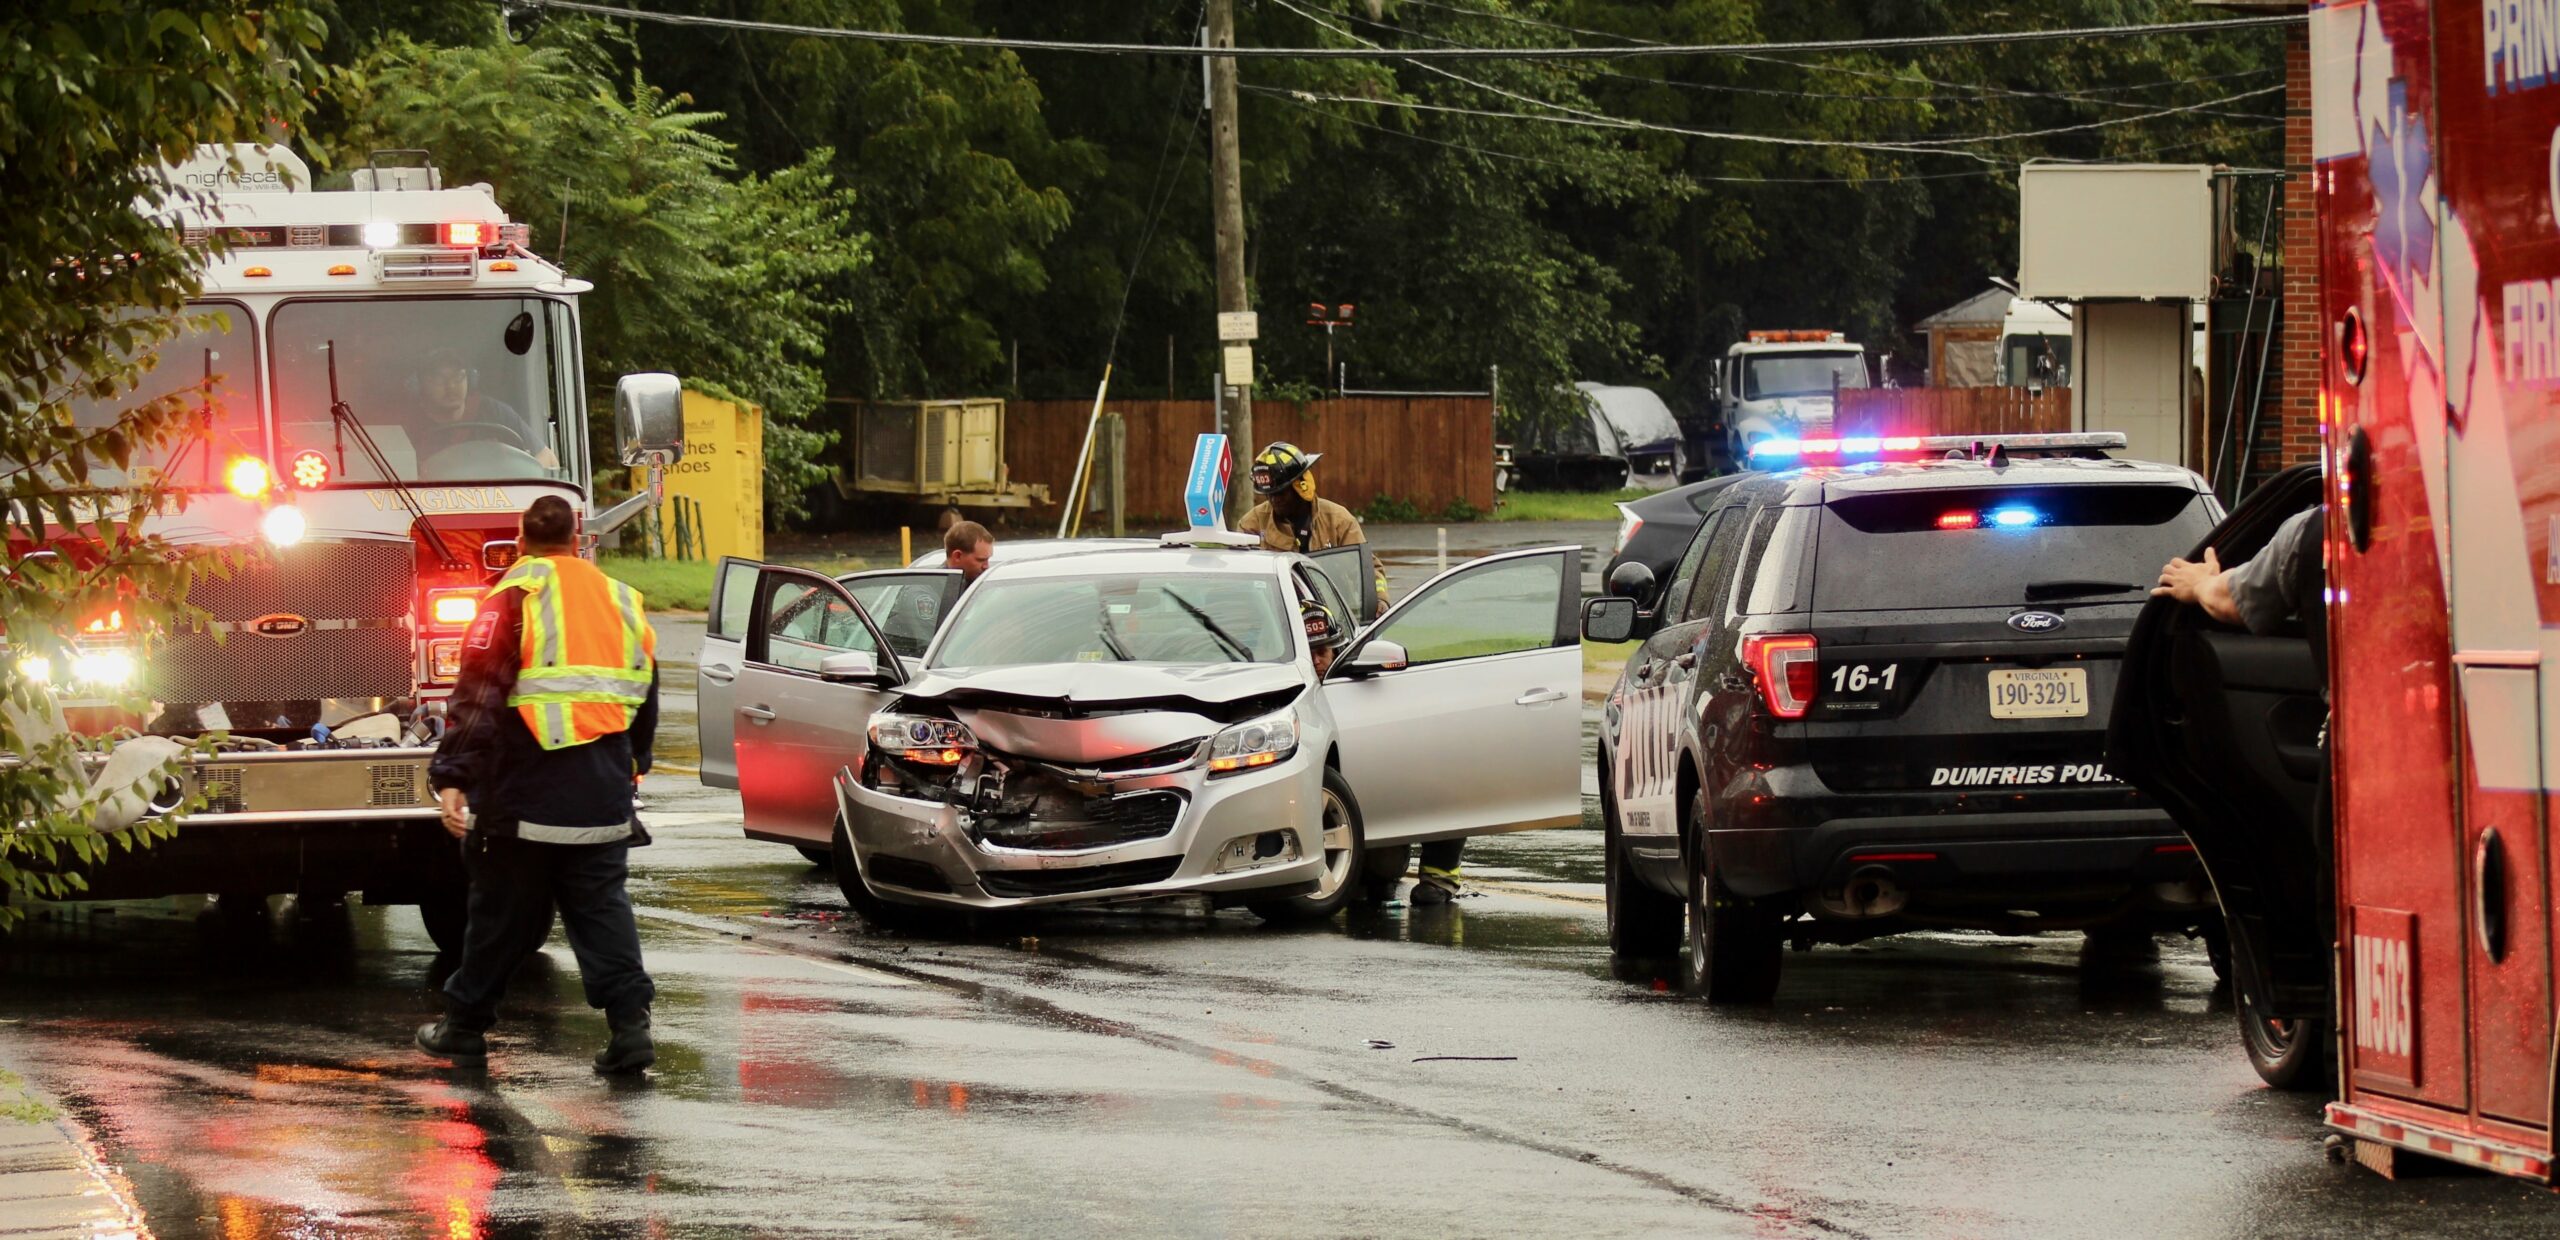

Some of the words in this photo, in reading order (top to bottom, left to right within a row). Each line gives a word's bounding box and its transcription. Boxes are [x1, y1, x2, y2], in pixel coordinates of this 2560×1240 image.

[186, 166, 283, 187] nighsca
[365, 487, 515, 512] VIRGINIA
[1305, 621, 1325, 633] 503
[2020, 614, 2052, 628] Ford
[1831, 663, 1898, 692] 16-1
[2014, 671, 2061, 681] VIRGINIA
[1930, 766, 2055, 786] DUMFRIES
[2059, 764, 2124, 784] POL
[2354, 934, 2412, 1057] M503
